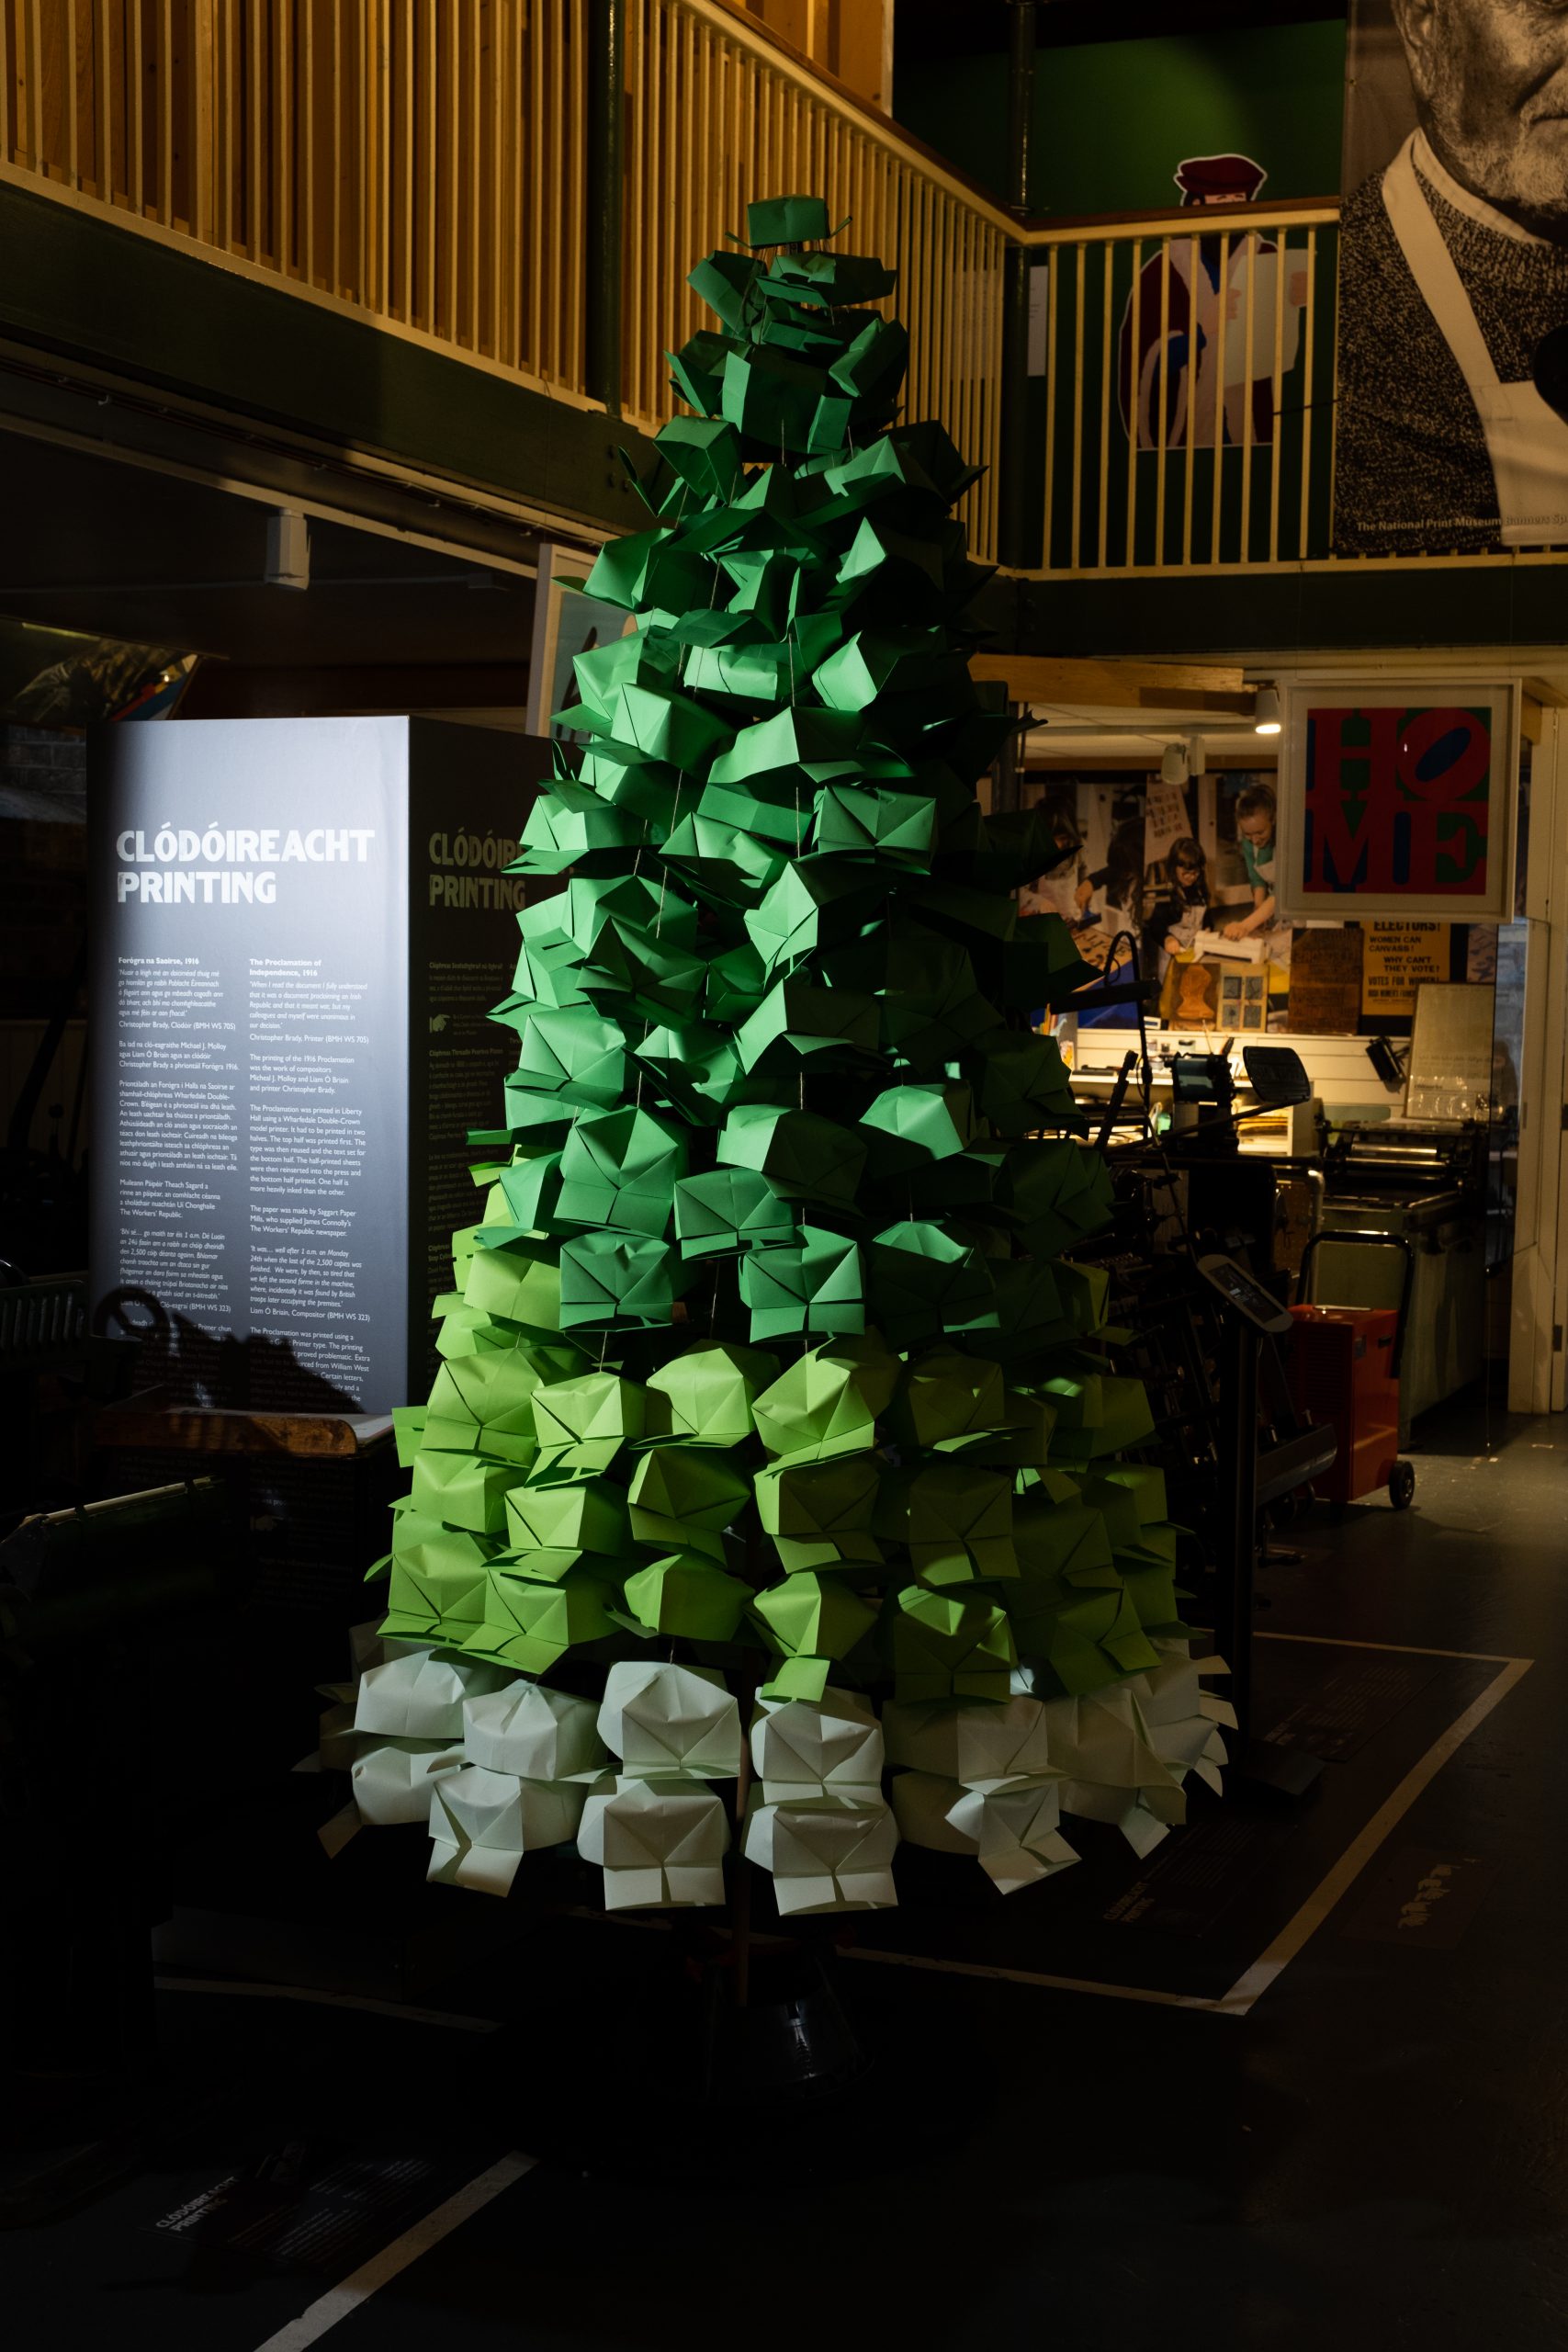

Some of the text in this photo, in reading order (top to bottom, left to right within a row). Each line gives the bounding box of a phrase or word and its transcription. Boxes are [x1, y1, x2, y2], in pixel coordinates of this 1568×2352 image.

[1357, 521, 1376, 531] The
[1378, 519, 1424, 530] National
[1426, 517, 1452, 528] Print
[1453, 516, 1502, 527] Museum
[117, 821, 375, 862] CLÓDÓIREACHT
[428, 826, 522, 869] CLÓDÓIR
[117, 871, 276, 904] PRINTING
[429, 874, 526, 910] PRINTING
[118, 956, 145, 965] Forógra
[156, 957, 184, 966] Saoirse,
[250, 969, 301, 978] Independence,
[119, 1021, 152, 1029] Christopher
[193, 1023, 210, 1031] (BMH
[223, 1023, 236, 1032] 705)
[250, 1034, 284, 1042] Christopher
[325, 1035, 344, 1044] (BMH
[356, 1035, 369, 1045] 705)
[208, 1043, 227, 1051] Molloy
[119, 1061, 152, 1069] Christopher
[202, 1063, 224, 1071] Forógra
[261, 1085, 281, 1093] printer
[282, 1085, 317, 1094] Christopher
[318, 1086, 335, 1094] Brady.
[312, 1107, 334, 1115] printed
[342, 1108, 362, 1116] Liberty
[318, 1117, 361, 1125] Double-Crown
[283, 1136, 293, 1144] top
[318, 1137, 339, 1146] printed
[309, 1157, 342, 1166] half-printed
[280, 1166, 310, 1174] reinserted
[266, 1186, 286, 1194] heavily
[158, 1210, 183, 1219] Republic.
[318, 1208, 339, 1216] Saggart
[340, 1209, 356, 1217] Paper
[290, 1227, 315, 1236] Republic
[189, 1302, 206, 1312] (BMH
[219, 1305, 231, 1314] 323)
[273, 1308, 290, 1317] Briain,
[292, 1309, 325, 1318] Compositor
[327, 1311, 344, 1320] (BMH
[358, 1313, 370, 1322] 323)
[263, 1328, 299, 1337] Proclamation
[312, 1331, 334, 1340] printed
[334, 1332, 350, 1340] using
[313, 1340, 327, 1349] type.
[342, 1342, 364, 1351] printing
[298, 1351, 318, 1359] proved
[319, 1351, 353, 1362] problematic.
[331, 1363, 353, 1371] William
[321, 1371, 364, 1383] Certain letters,
